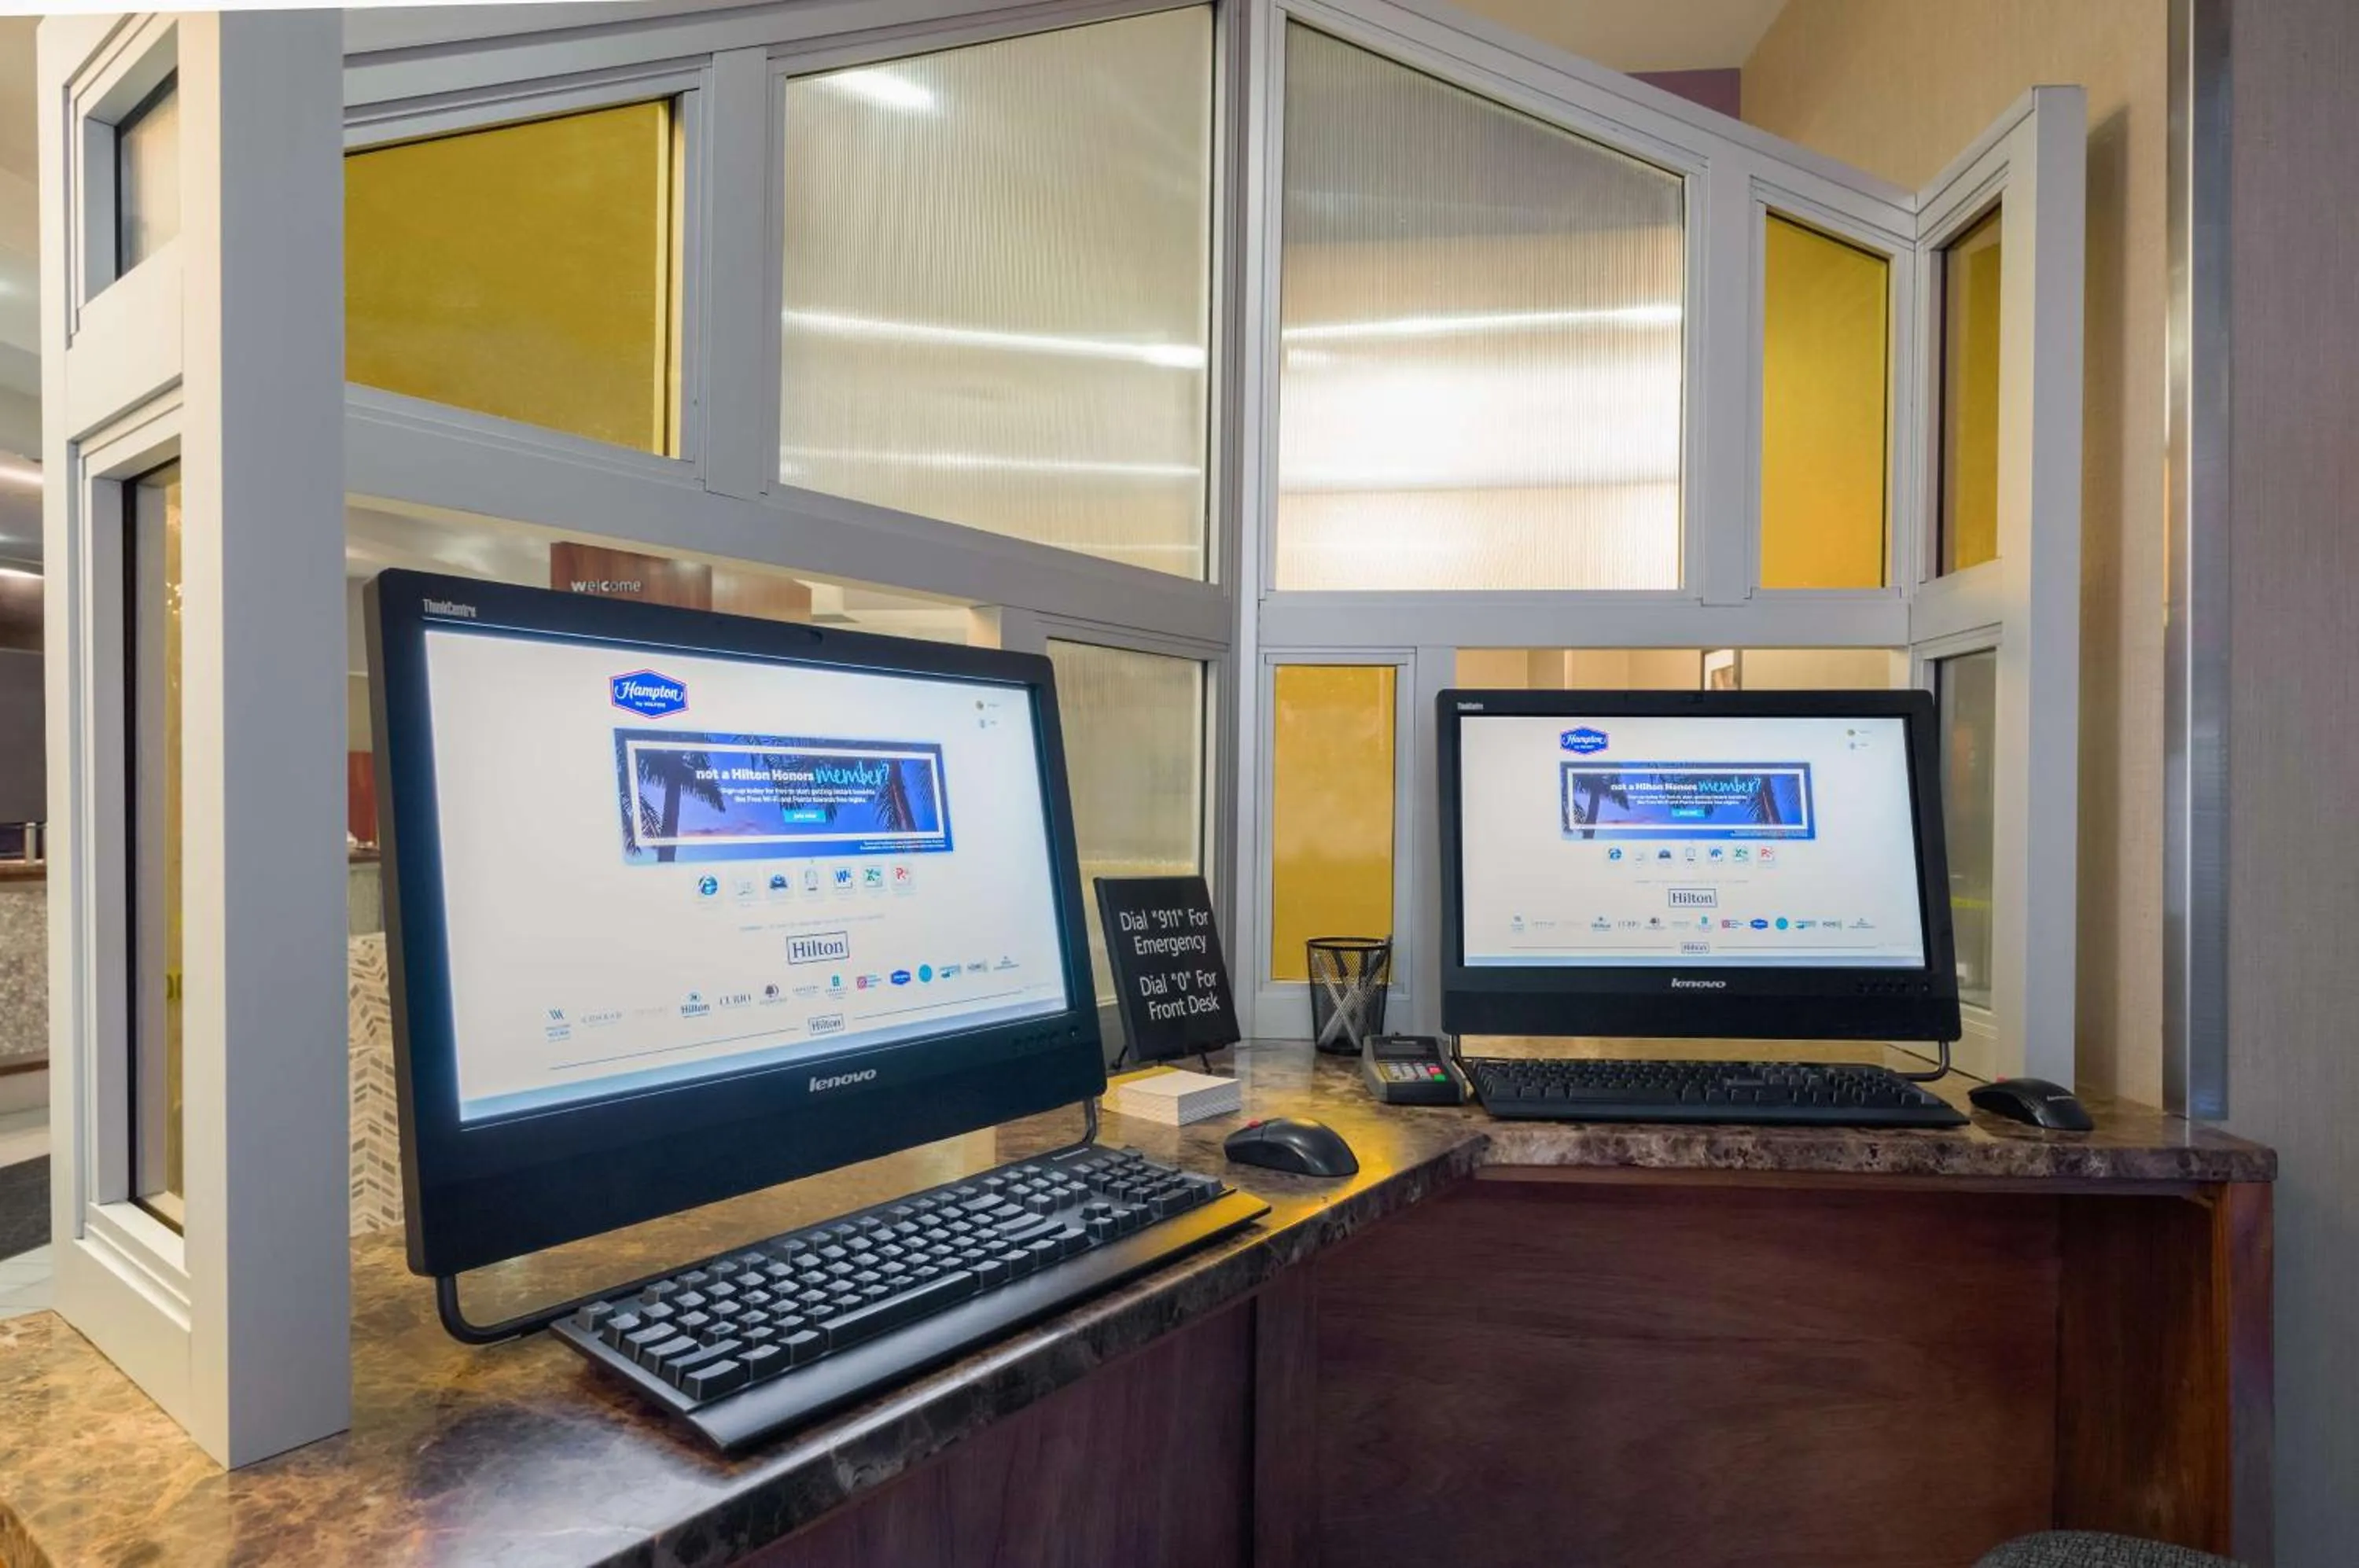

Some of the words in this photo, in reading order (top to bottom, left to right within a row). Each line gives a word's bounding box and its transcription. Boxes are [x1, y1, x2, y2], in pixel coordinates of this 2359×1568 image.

[571, 580, 641, 592] welcome
[422, 598, 477, 617] ThinkCentre
[615, 681, 683, 701] Hampton
[696, 769, 719, 780] not
[721, 771, 731, 780] a
[731, 768, 771, 781] Hilton
[771, 769, 814, 781] Honors
[815, 760, 889, 786] member?
[1672, 893, 1713, 904] Hilton
[1119, 910, 1149, 931] Dial
[1188, 908, 1209, 926] For
[792, 940, 845, 959] Hilton
[1134, 935, 1206, 957] Emergency
[1139, 973, 1168, 996] Dial
[1195, 970, 1217, 989] For
[1671, 977, 1726, 988] lenovo
[681, 1003, 710, 1014] Hilton
[1149, 999, 1187, 1021] Front
[1188, 992, 1220, 1014] Desk
[812, 1018, 841, 1032] Hilton
[808, 1069, 877, 1092] lenovo
